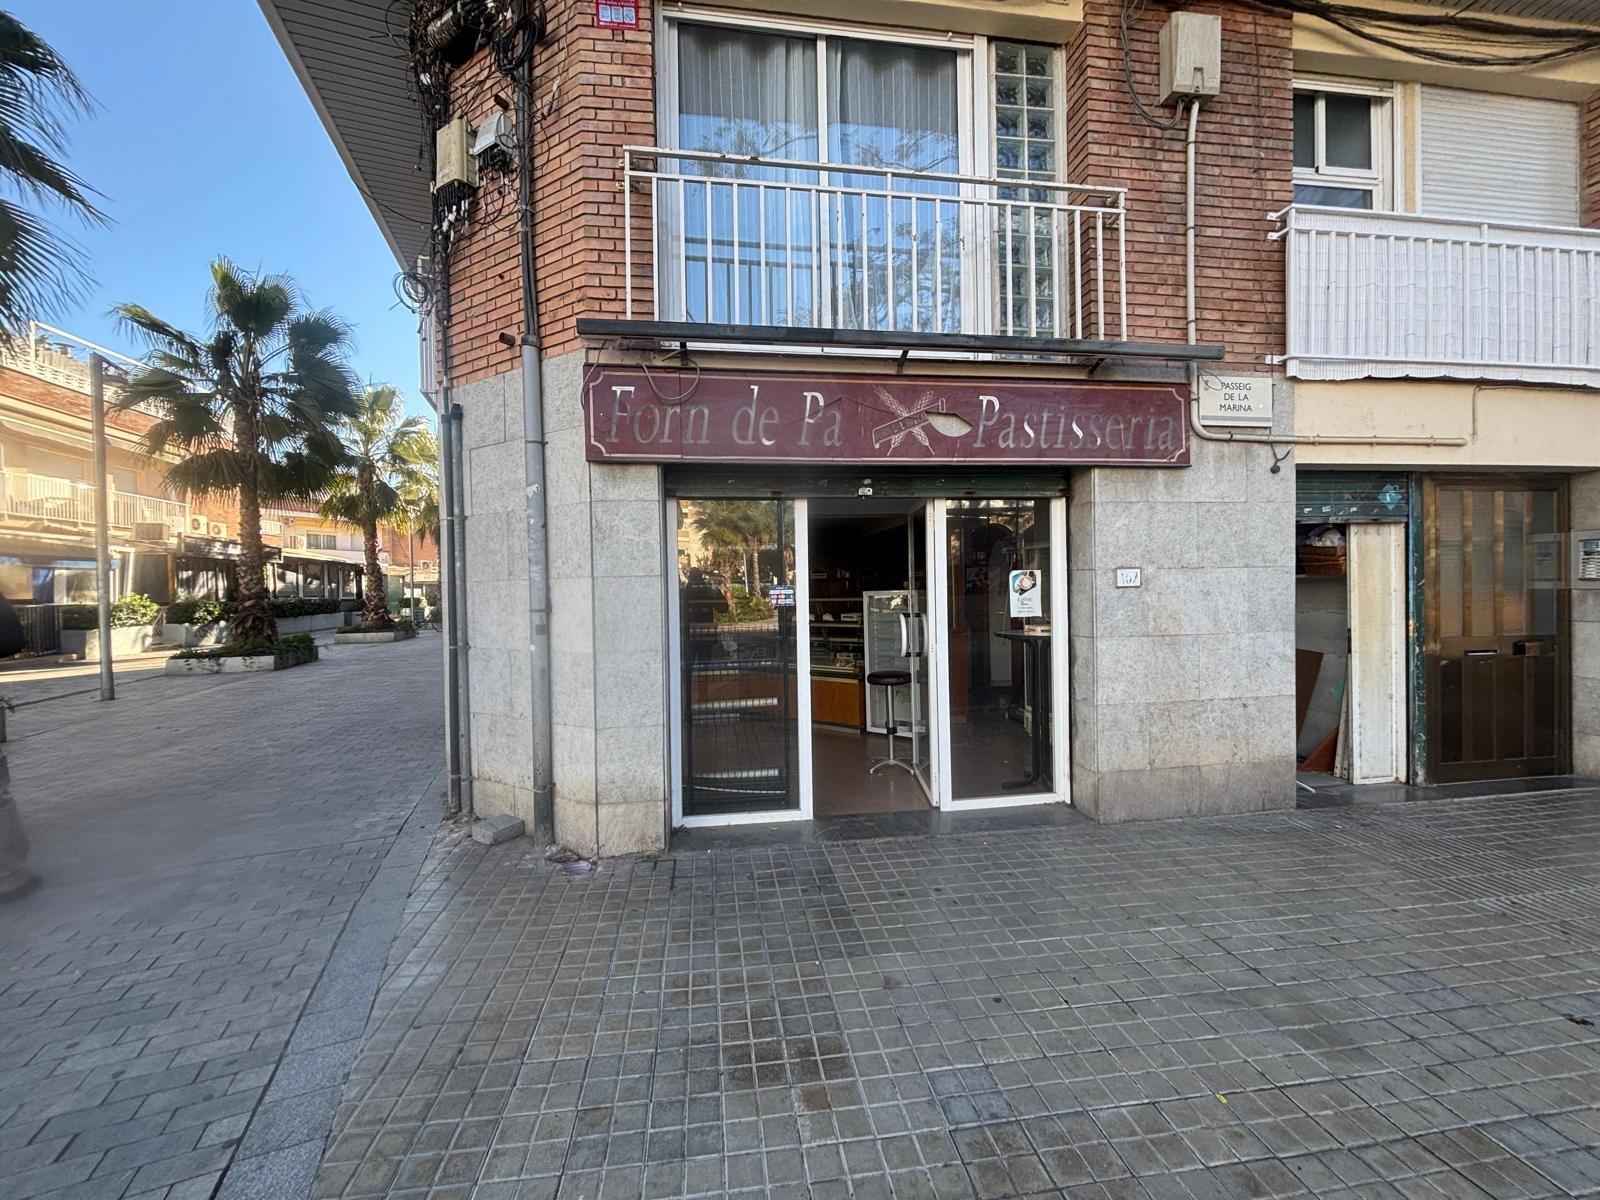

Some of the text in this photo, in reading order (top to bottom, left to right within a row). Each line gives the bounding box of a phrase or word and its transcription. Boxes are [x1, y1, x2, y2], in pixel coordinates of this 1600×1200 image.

[1221, 382, 1252, 391] PASSEIG
[1224, 393, 1249, 401] DE LA
[1220, 404, 1252, 412] MARINA
[606, 385, 1176, 451] Forn de Pa Pastisseria
